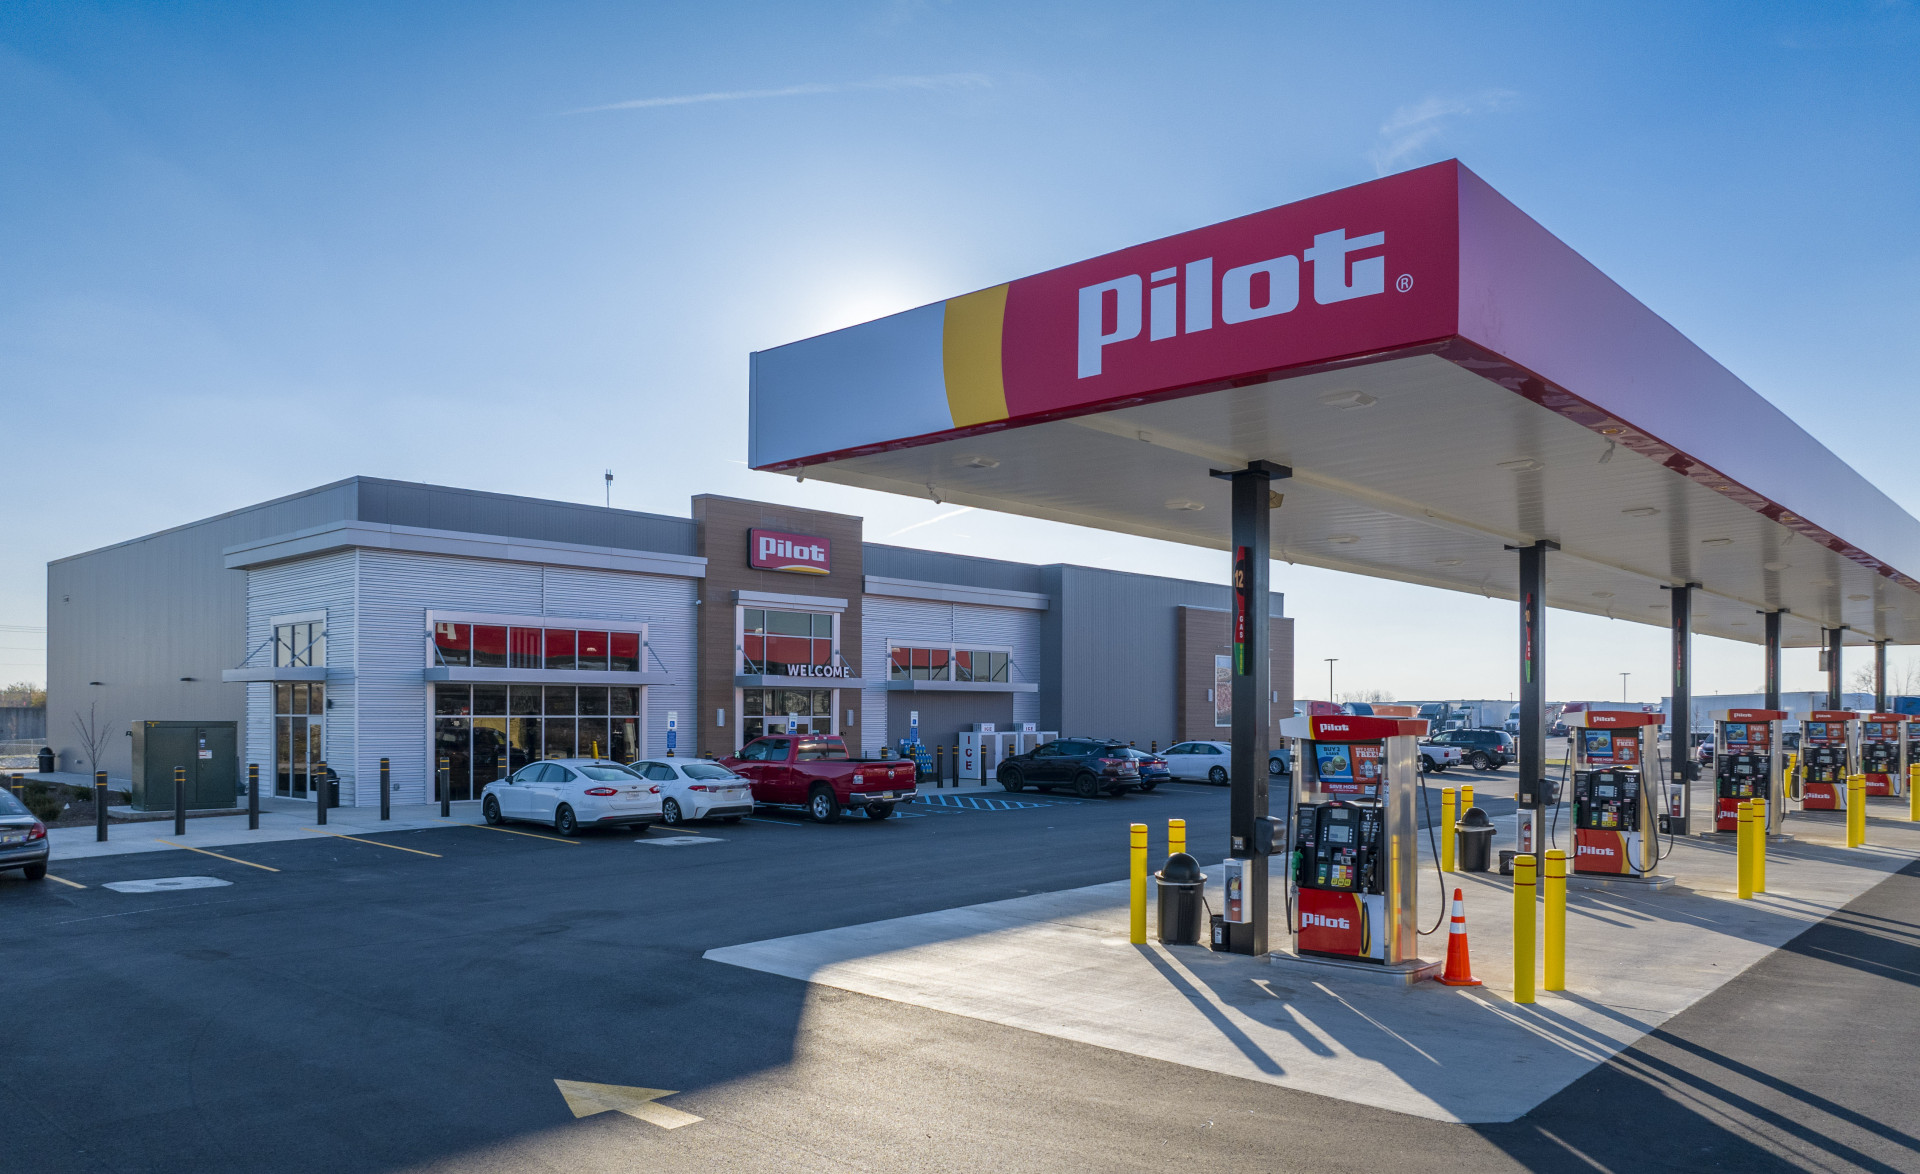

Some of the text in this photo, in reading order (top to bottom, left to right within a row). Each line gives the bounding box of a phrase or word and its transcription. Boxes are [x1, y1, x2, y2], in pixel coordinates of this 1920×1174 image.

[1077, 227, 1385, 380] Pilot
[759, 536, 825, 562] Pilot
[1235, 570, 1244, 588] 12
[787, 664, 850, 678] WELCOME
[1320, 723, 1349, 732] Pilot
[1577, 845, 1615, 856] Pilot
[1302, 912, 1350, 929] Pilot
